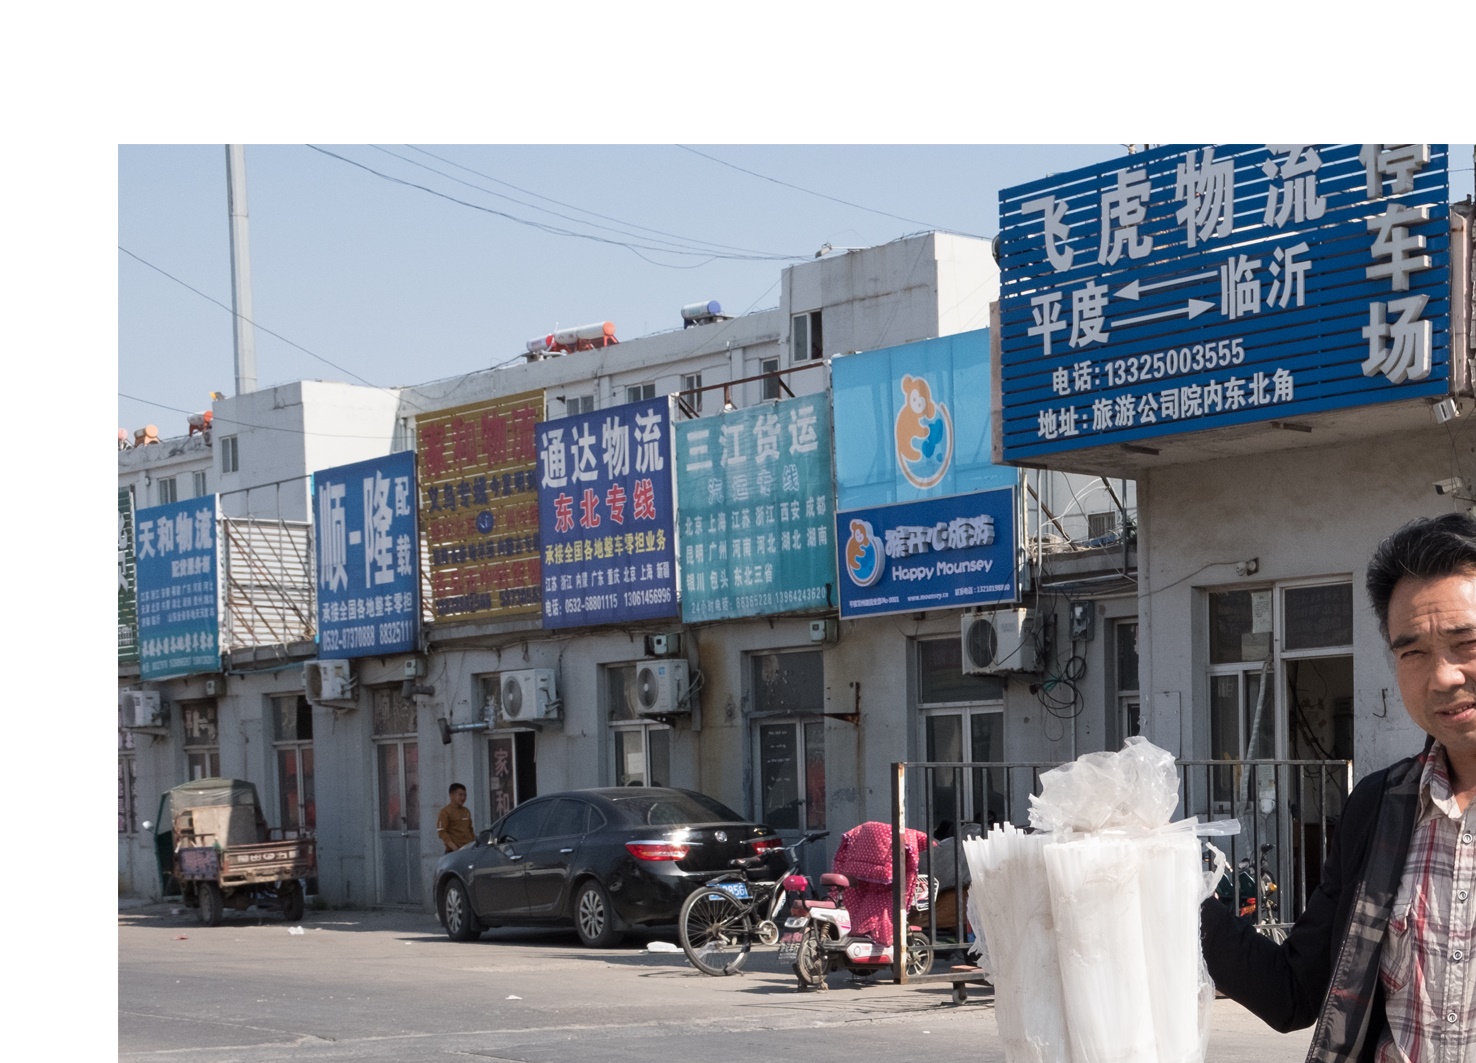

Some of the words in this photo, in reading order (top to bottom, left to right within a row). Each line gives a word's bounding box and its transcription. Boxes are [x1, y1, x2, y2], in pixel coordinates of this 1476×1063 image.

[1021, 144, 1328, 273] 飞虎物流
[1026, 281, 1111, 357] 平度
[1220, 241, 1313, 321] 临沂
[540, 408, 664, 490] 通达物流
[686, 405, 819, 472] 三江货运
[554, 478, 656, 534] 东北专线
[685, 516, 703, 536] 北京
[708, 511, 727, 533] 上海
[731, 507, 751, 529] 江苏
[755, 504, 775, 527] 浙江
[780, 500, 800, 522] 西安
[805, 495, 826, 518] 成都
[138, 507, 213, 560] 天和物流
[545, 528, 666, 566] 承接全国各地整车零担业务
[686, 543, 704, 565] 昆明
[709, 541, 727, 562] 广州
[732, 538, 751, 558] 河南
[756, 533, 776, 555] 河北
[781, 529, 801, 551] 湖北
[806, 525, 827, 547] 湖南
[545, 576, 557, 593] 江苏
[560, 574, 573, 590] 浙江
[575, 572, 589, 589] 内蒙
[591, 569, 604, 587] 广东
[607, 567, 620, 585] 重庆
[623, 565, 637, 583] 北京
[640, 562, 653, 581] 上海
[656, 561, 670, 579] 新疆
[709, 570, 729, 590] 包头
[734, 563, 773, 587] 东北三省
[892, 565, 934, 582] Happy
[936, 559, 993, 577] Mounsey
[321, 592, 413, 623] 承接全国各地整车零担
